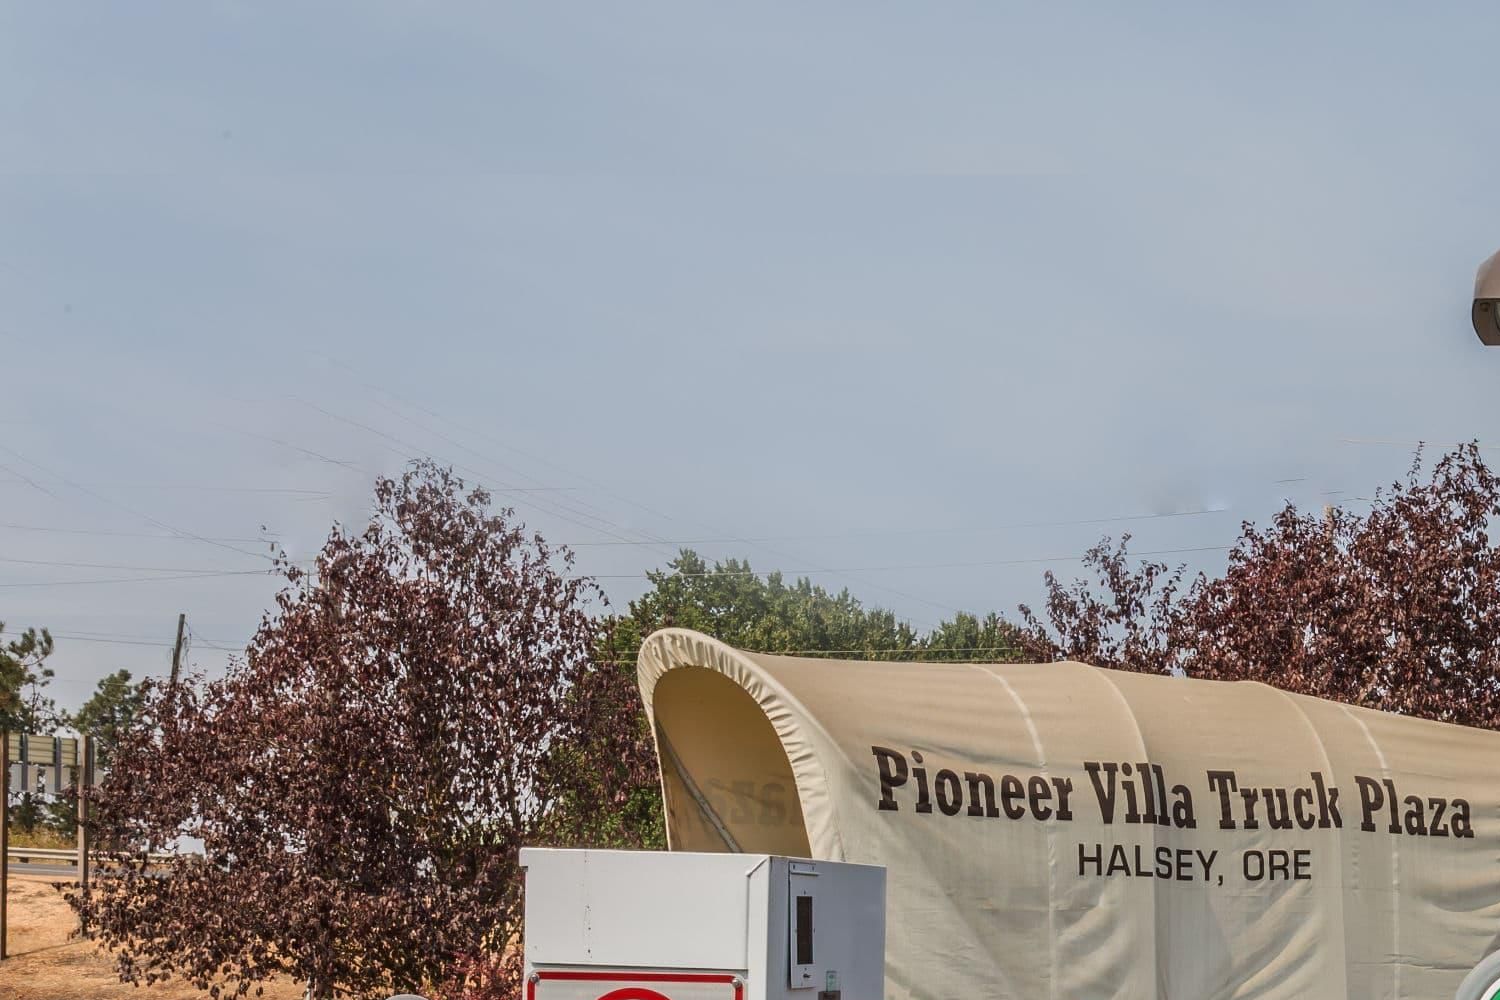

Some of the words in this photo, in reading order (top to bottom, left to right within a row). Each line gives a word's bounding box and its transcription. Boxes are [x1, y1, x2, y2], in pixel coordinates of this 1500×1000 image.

[872, 745, 1073, 821] Pioneer
[1084, 761, 1197, 829] Villa
[1206, 770, 1343, 830] Truck
[1354, 775, 1475, 838] Plaza
[1078, 843, 1224, 886] HALSEY,
[1243, 849, 1312, 881] ORE
